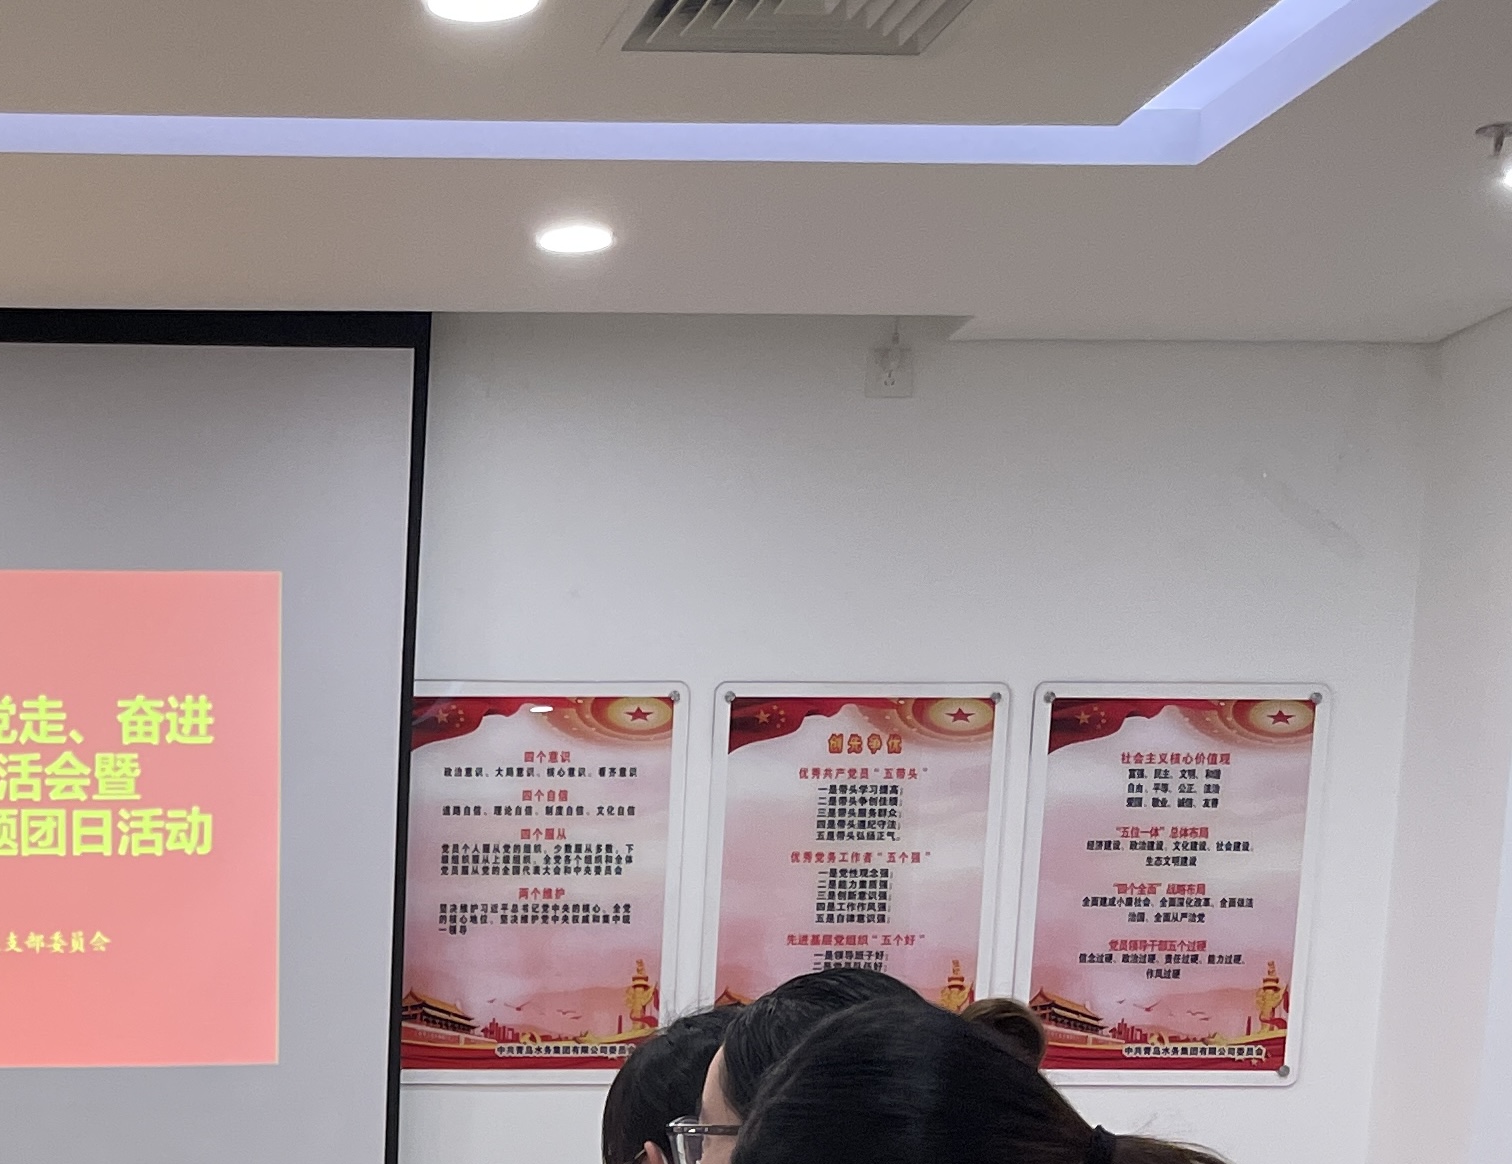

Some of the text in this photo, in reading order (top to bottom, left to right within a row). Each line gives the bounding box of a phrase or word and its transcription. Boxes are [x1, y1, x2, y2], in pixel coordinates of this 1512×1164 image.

[524, 751, 571, 763] 四个意识
[522, 790, 568, 802] 四个自信
